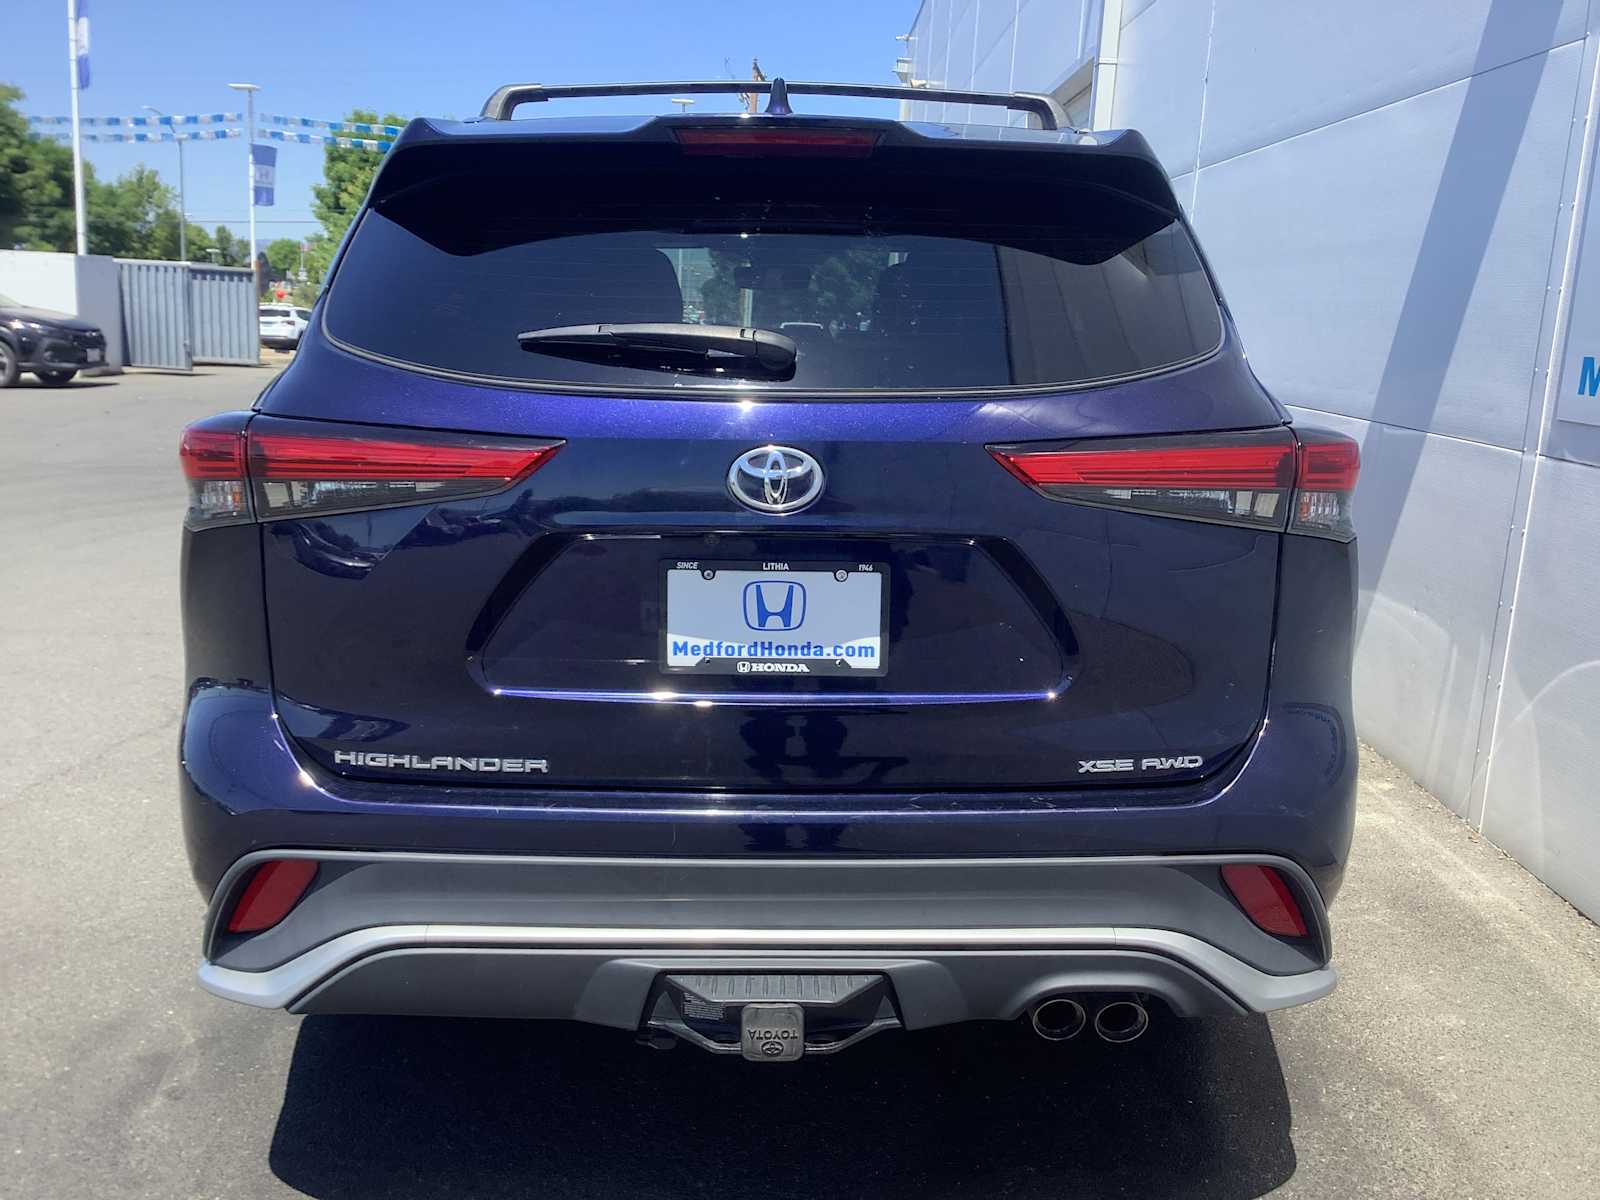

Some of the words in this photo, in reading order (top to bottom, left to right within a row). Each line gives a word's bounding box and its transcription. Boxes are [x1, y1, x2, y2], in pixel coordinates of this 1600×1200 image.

[676, 562, 698, 570] SINCE
[762, 562, 789, 571] LITHIA
[672, 641, 875, 658] MedfordHonda.com
[750, 663, 810, 673] HONDA
[334, 750, 549, 773] HIGHLANDER
[1078, 759, 1134, 773] XSE
[1141, 755, 1203, 770] AWD
[746, 1030, 798, 1041] TOYOTA
